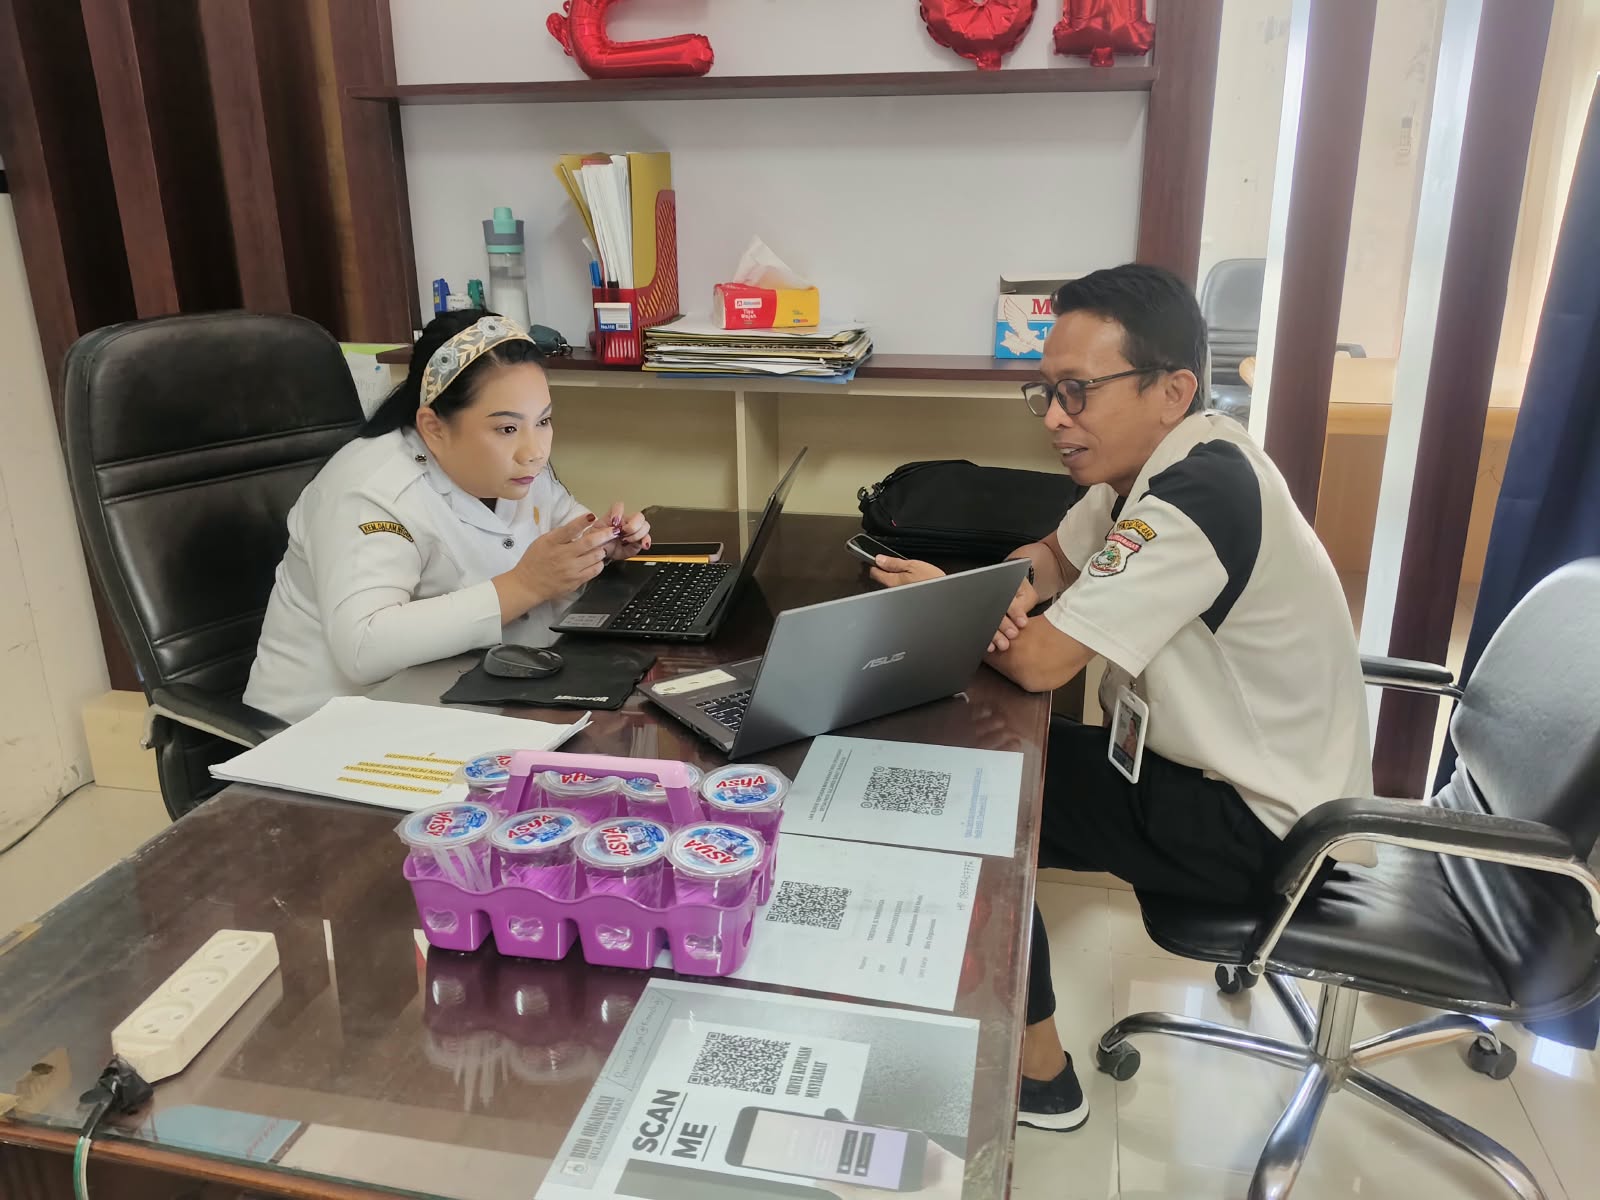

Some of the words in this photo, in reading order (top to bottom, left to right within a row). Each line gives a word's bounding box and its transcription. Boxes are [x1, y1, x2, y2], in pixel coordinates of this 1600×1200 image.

[862, 651, 906, 670] ASUS
[632, 1089, 680, 1153] SCAN
[671, 1122, 709, 1160] ME
